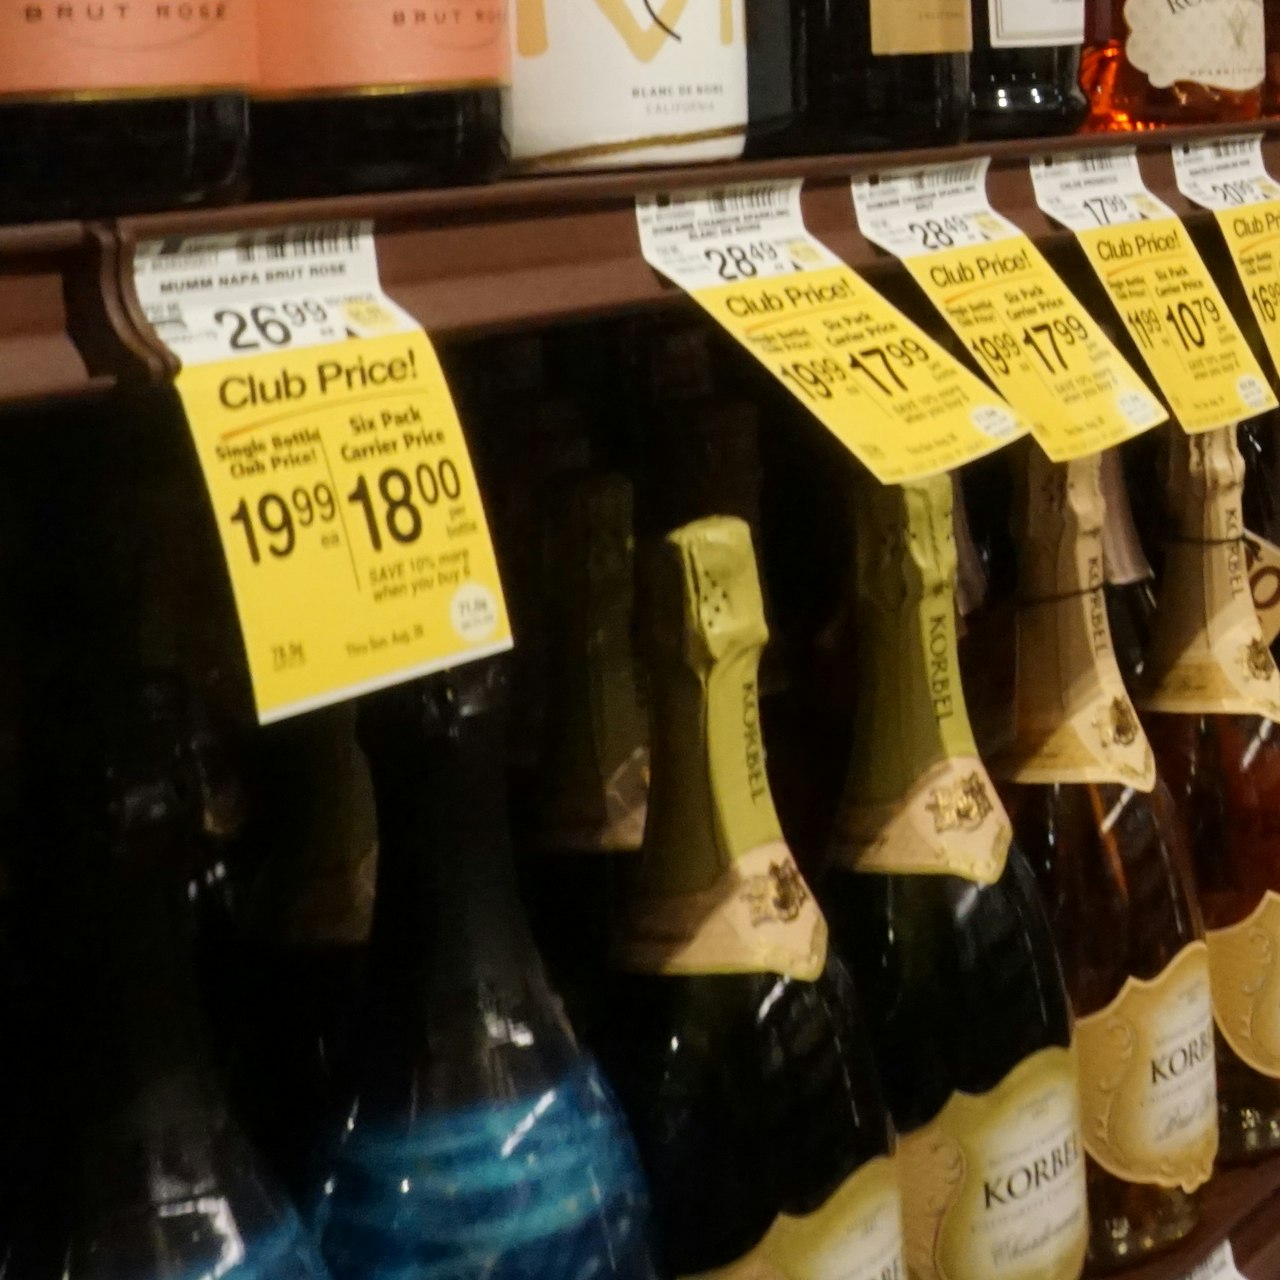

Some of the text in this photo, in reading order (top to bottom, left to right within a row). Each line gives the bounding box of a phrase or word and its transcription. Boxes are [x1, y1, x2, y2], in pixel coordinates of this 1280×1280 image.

[25, 3, 129, 22] BRUT
[392, 8, 462, 27] BRUT
[632, 84, 674, 99] BLANC
[1233, 216, 1264, 237] Club
[1097, 228, 1183, 262] Club Price!
[160, 262, 348, 294] MUMM NAPA BRUT ROSE
[929, 248, 1034, 288] Club Price!
[724, 275, 857, 319] Club Price!
[218, 348, 418, 410] Club Price!
[349, 404, 423, 435] Six Pack
[215, 428, 322, 462] Single Bottle
[340, 428, 446, 462] Carrier Price
[230, 450, 318, 480] Club Price!
[368, 548, 470, 586] SAVE 10% more
[372, 569, 462, 603] when you buy
[927, 610, 956, 724] KORBEL
